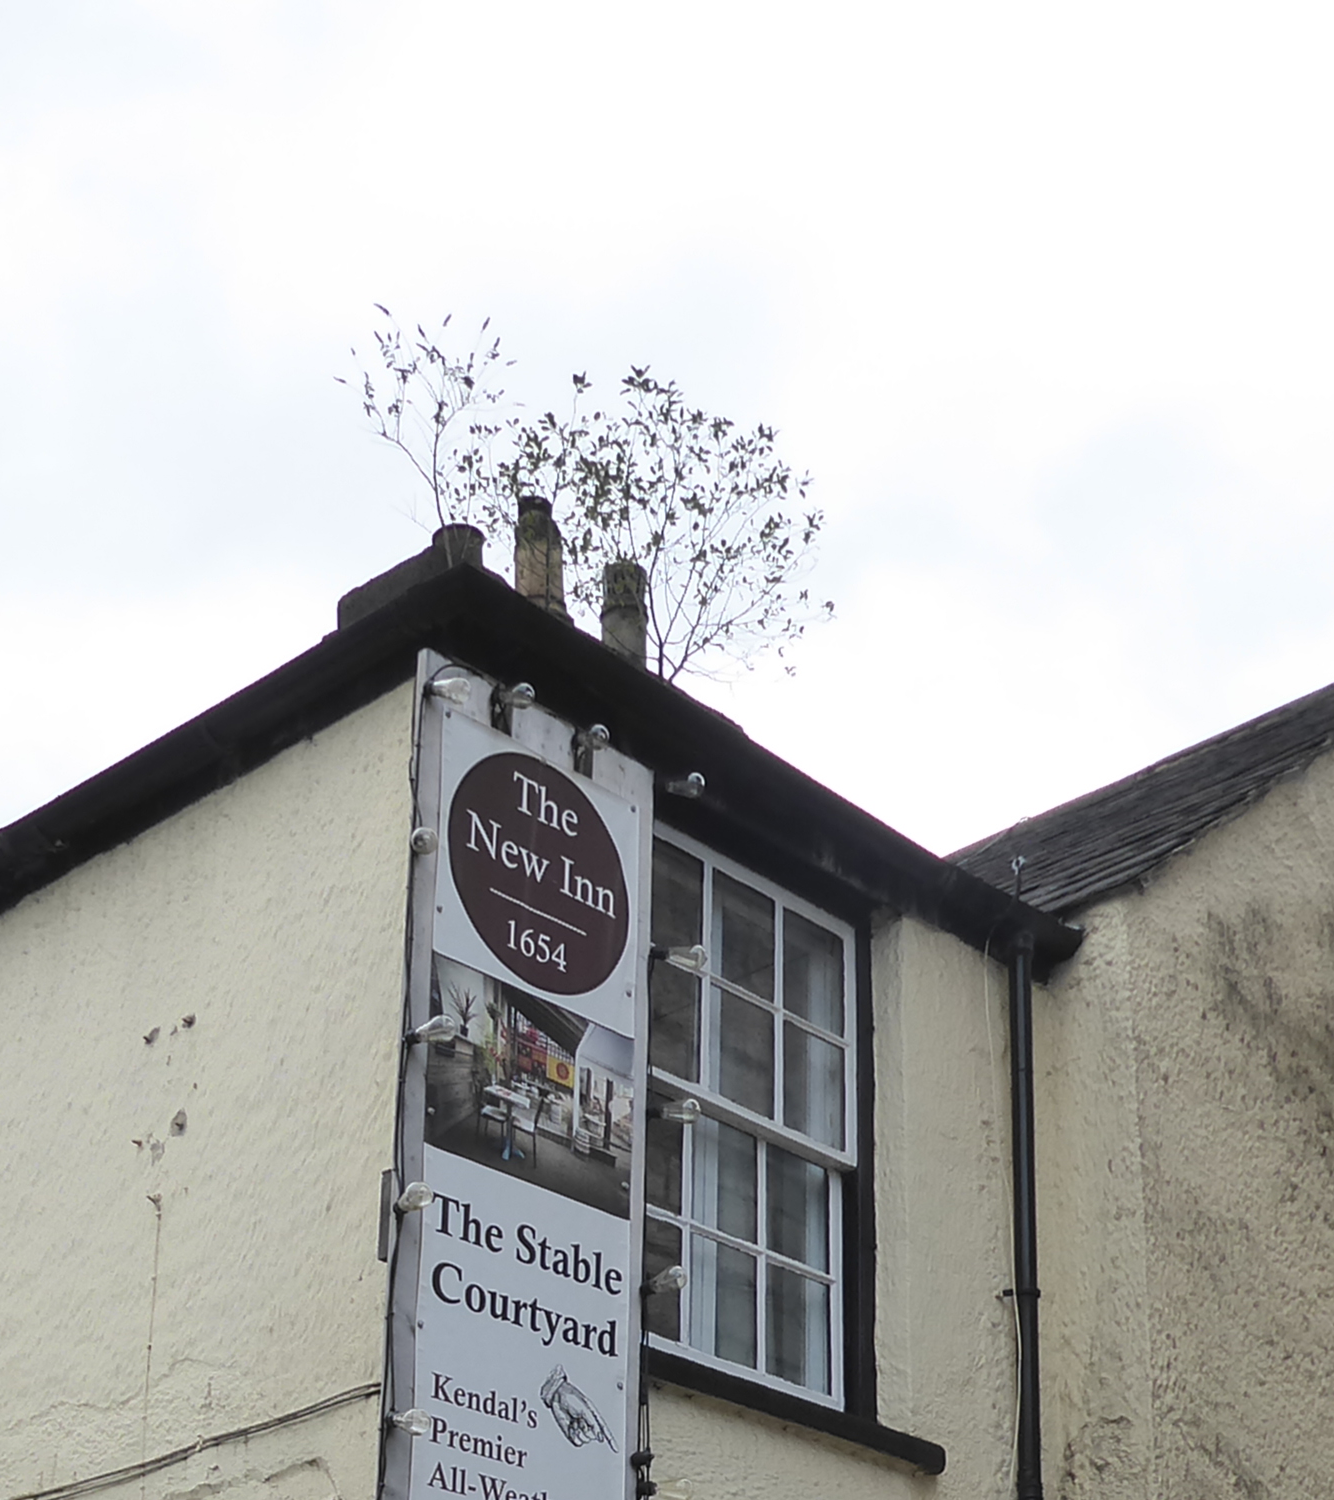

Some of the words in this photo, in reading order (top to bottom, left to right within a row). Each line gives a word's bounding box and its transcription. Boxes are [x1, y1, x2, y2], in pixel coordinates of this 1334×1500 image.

[513, 770, 578, 836] The
[466, 808, 550, 883] New
[559, 855, 616, 919] Inn
[506, 919, 567, 972] 1654
[433, 1192, 504, 1253] The
[515, 1223, 622, 1295] Stable
[431, 1261, 618, 1358] Courtyard
[430, 1371, 538, 1429] Kendal's
[428, 1415, 528, 1468] Premier
